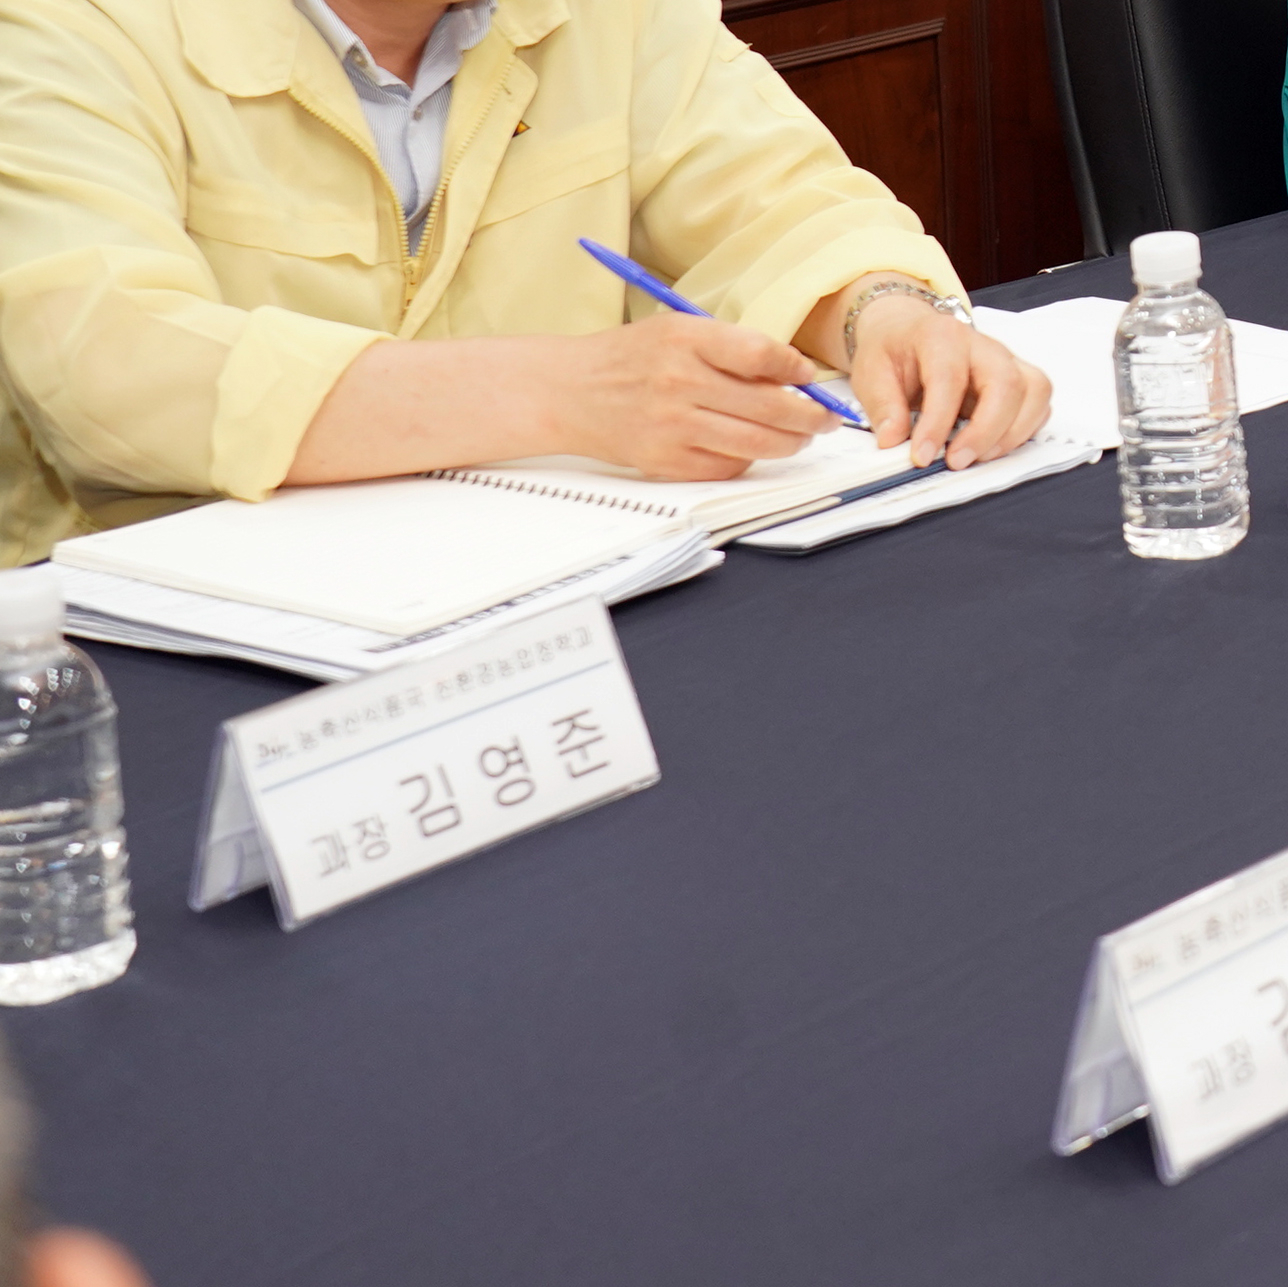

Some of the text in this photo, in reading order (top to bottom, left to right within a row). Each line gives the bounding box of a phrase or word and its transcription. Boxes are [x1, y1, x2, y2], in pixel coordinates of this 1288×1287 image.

[297, 683, 427, 750] 농축산식품국
[311, 707, 612, 880] 과장 김영준
[1190, 1036, 1256, 1101] 과장
